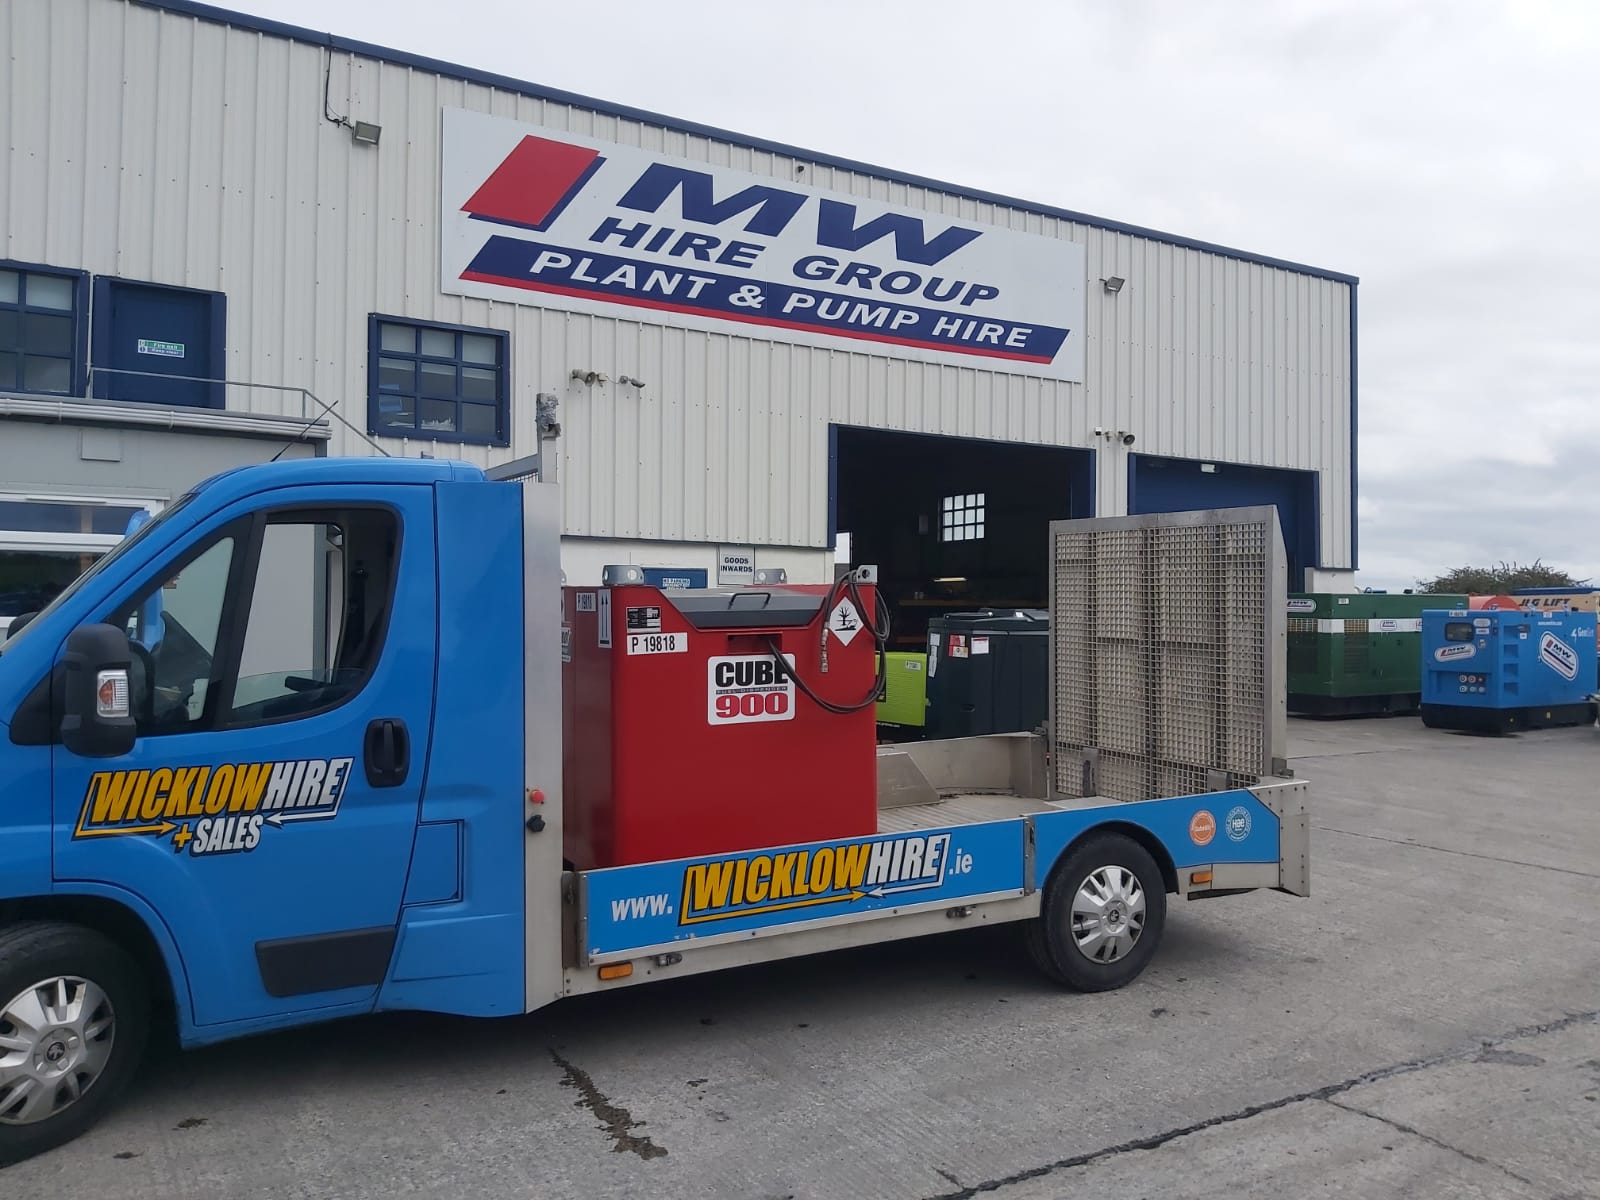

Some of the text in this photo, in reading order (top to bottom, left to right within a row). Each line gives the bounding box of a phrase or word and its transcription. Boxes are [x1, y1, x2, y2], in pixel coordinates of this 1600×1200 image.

[616, 162, 984, 267] MW
[589, 217, 1000, 307] HIRE GROUP
[529, 251, 1033, 348] PLANT & PUMP HIRE
[720, 565, 753, 573] INWARDS
[724, 556, 749, 564] GOODS
[1543, 598, 1571, 607] LIFT
[632, 635, 675, 653] P 19818
[1553, 643, 1572, 659] MW
[716, 661, 788, 687] CUBE
[716, 692, 789, 718] 900
